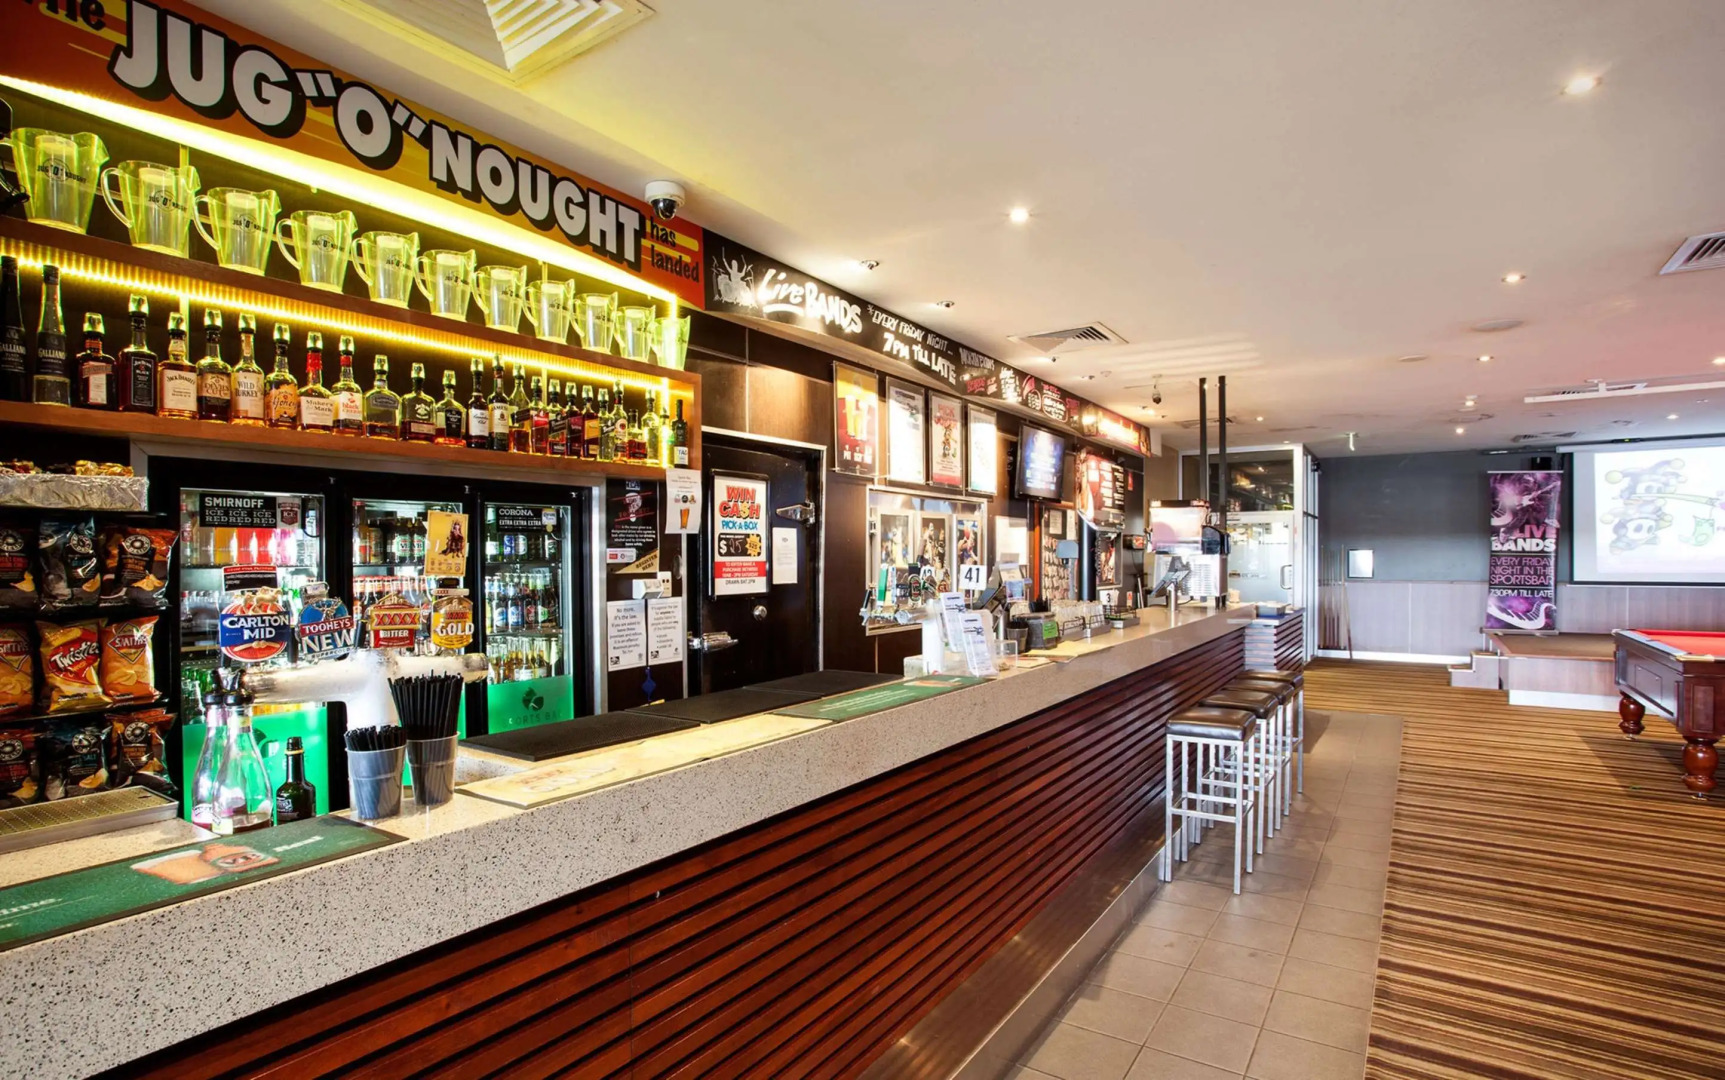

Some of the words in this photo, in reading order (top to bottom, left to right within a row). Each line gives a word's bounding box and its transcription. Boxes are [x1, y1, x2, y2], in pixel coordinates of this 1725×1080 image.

[109, 0, 300, 133] JUG
[411, 122, 641, 266] NOUGHT
[649, 218, 676, 248] has
[651, 244, 699, 283] landed
[756, 268, 804, 304] Live
[803, 281, 863, 334] BANDS
[38, 347, 66, 360] GALLIANO
[883, 331, 910, 360] 7PM
[931, 352, 957, 386] LATE
[237, 380, 255, 390] WILD
[235, 388, 259, 398] TURKEY
[726, 485, 756, 503] WIN
[204, 496, 264, 508] SMIRNOFF
[499, 508, 534, 516] CORONA
[1513, 523, 1557, 540] LIVE
[1491, 538, 1557, 552] BANDS
[1490, 557, 1519, 566] EVERY
[1522, 556, 1554, 566] FRIDAY
[964, 567, 980, 583] 41
[1490, 566, 1521, 575] NIGHT
[1523, 566, 1534, 575] IN
[1536, 566, 1554, 575] THE
[1490, 575, 1554, 585] SPORTSBAR
[1519, 589, 1532, 597] TILL
[1534, 589, 1553, 598] LATE
[222, 615, 289, 629] CARLTON
[302, 619, 351, 634] TOOHEYS
[374, 613, 418, 626] XXXX
[243, 628, 276, 640] MID
[379, 629, 409, 638] BITTER
[438, 622, 474, 636] GOLD
[301, 629, 356, 655] NEW
